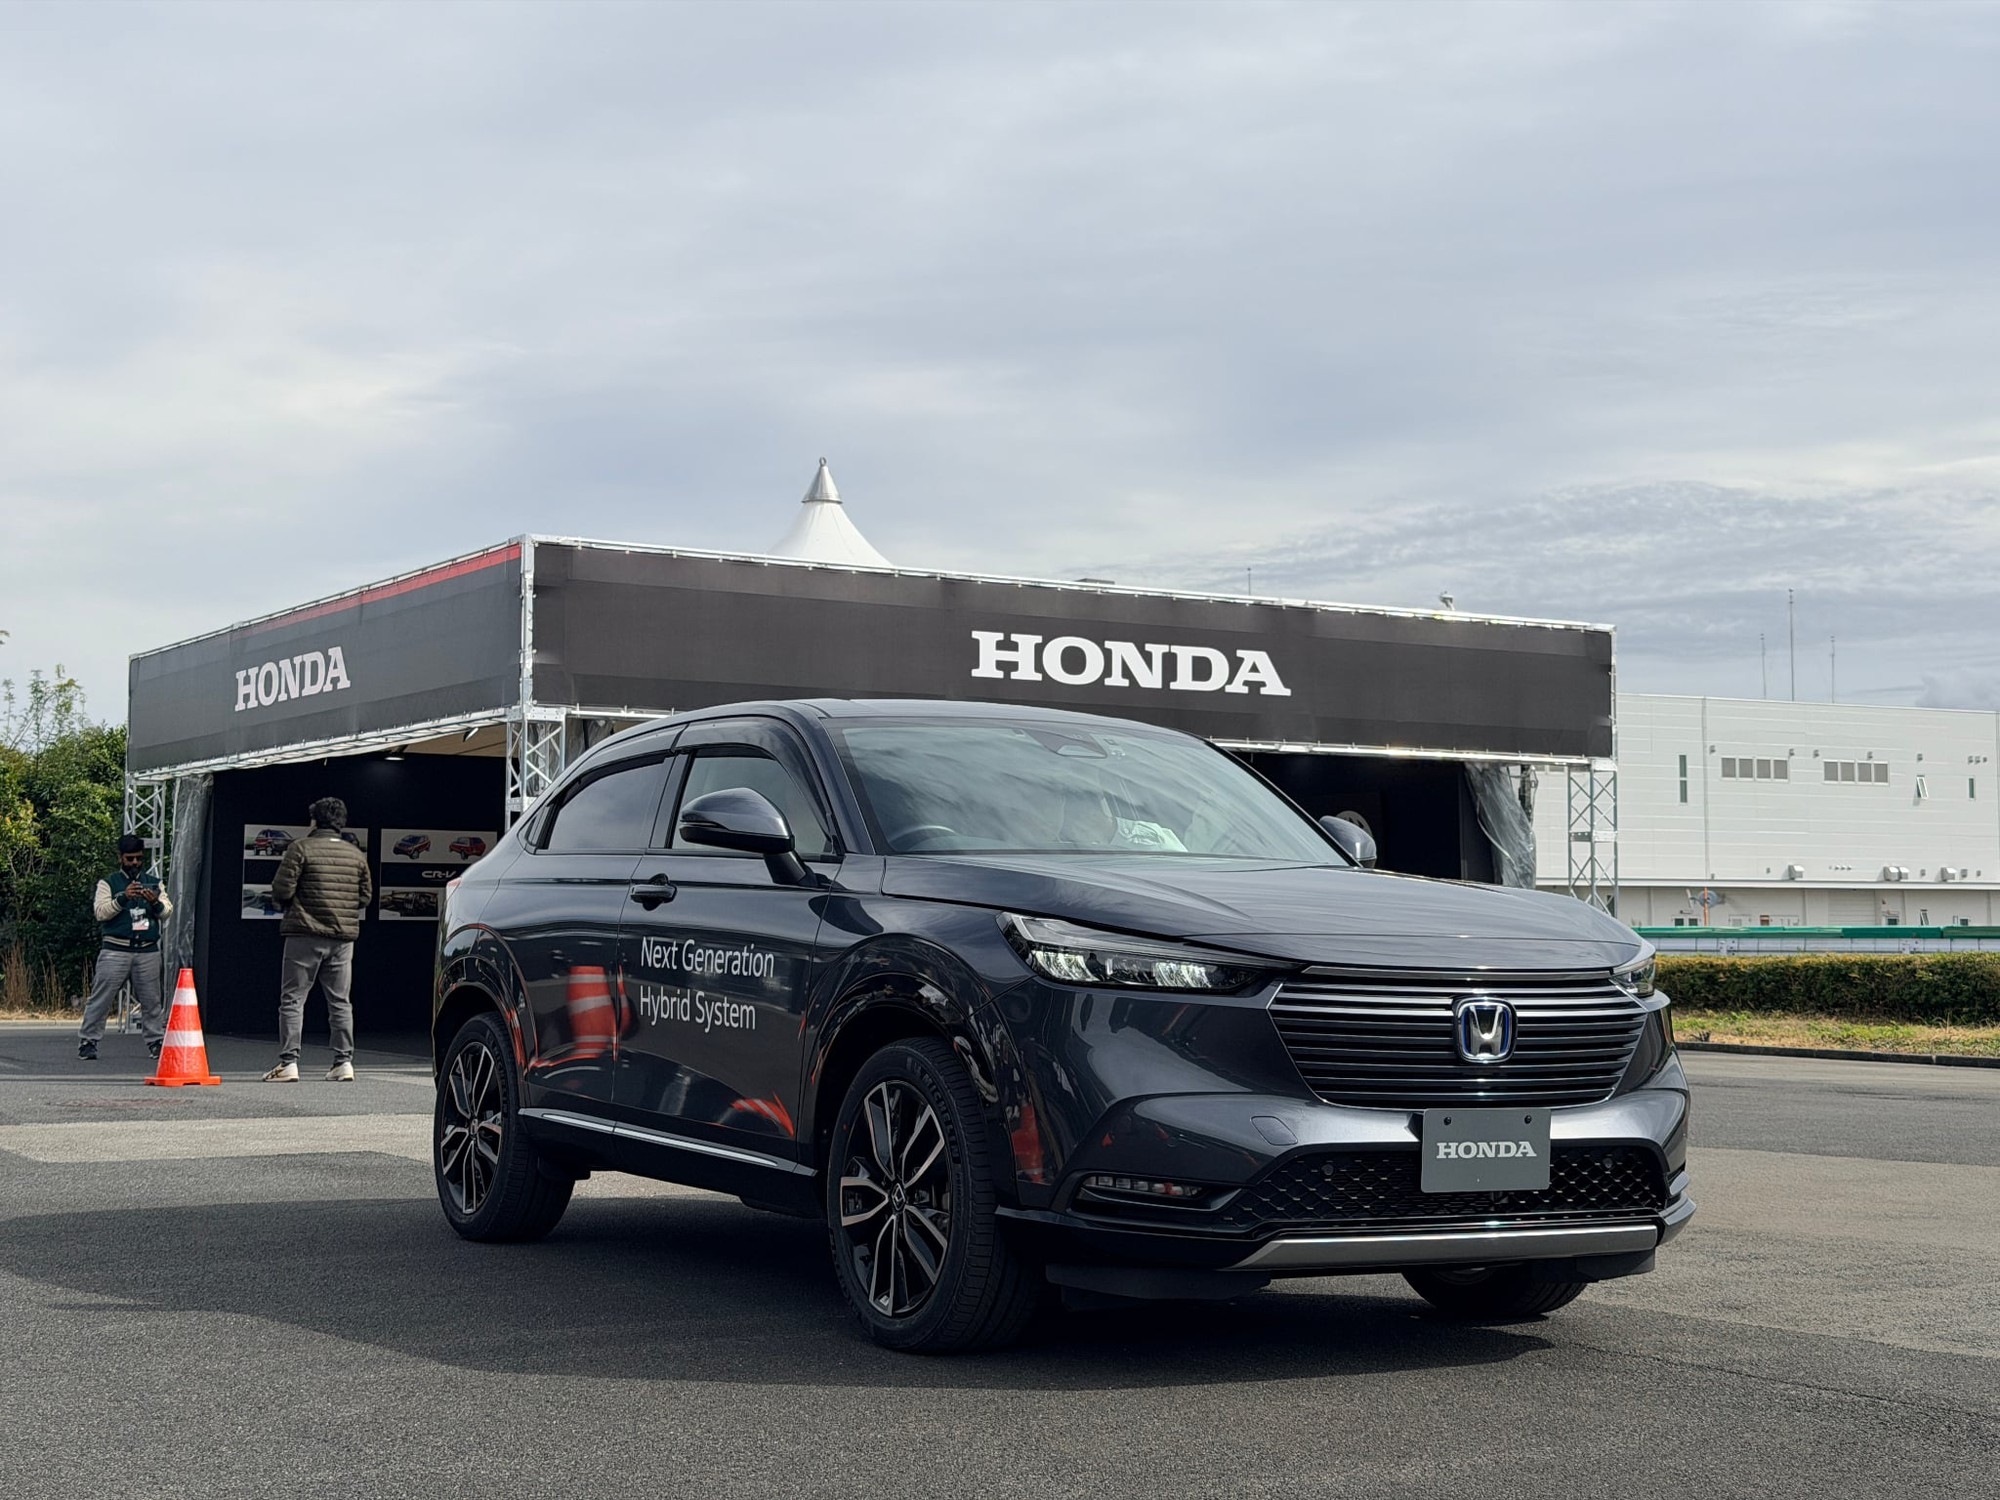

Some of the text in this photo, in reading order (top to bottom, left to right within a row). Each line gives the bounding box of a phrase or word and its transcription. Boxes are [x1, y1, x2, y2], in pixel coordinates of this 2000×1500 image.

[234, 645, 351, 711] HONDA
[971, 630, 1292, 696] HONDA
[421, 870, 457, 878] CR-V
[640, 936, 775, 978] Next Generation
[640, 985, 756, 1033] Hybrid System
[1436, 1141, 1537, 1159] HONDA
